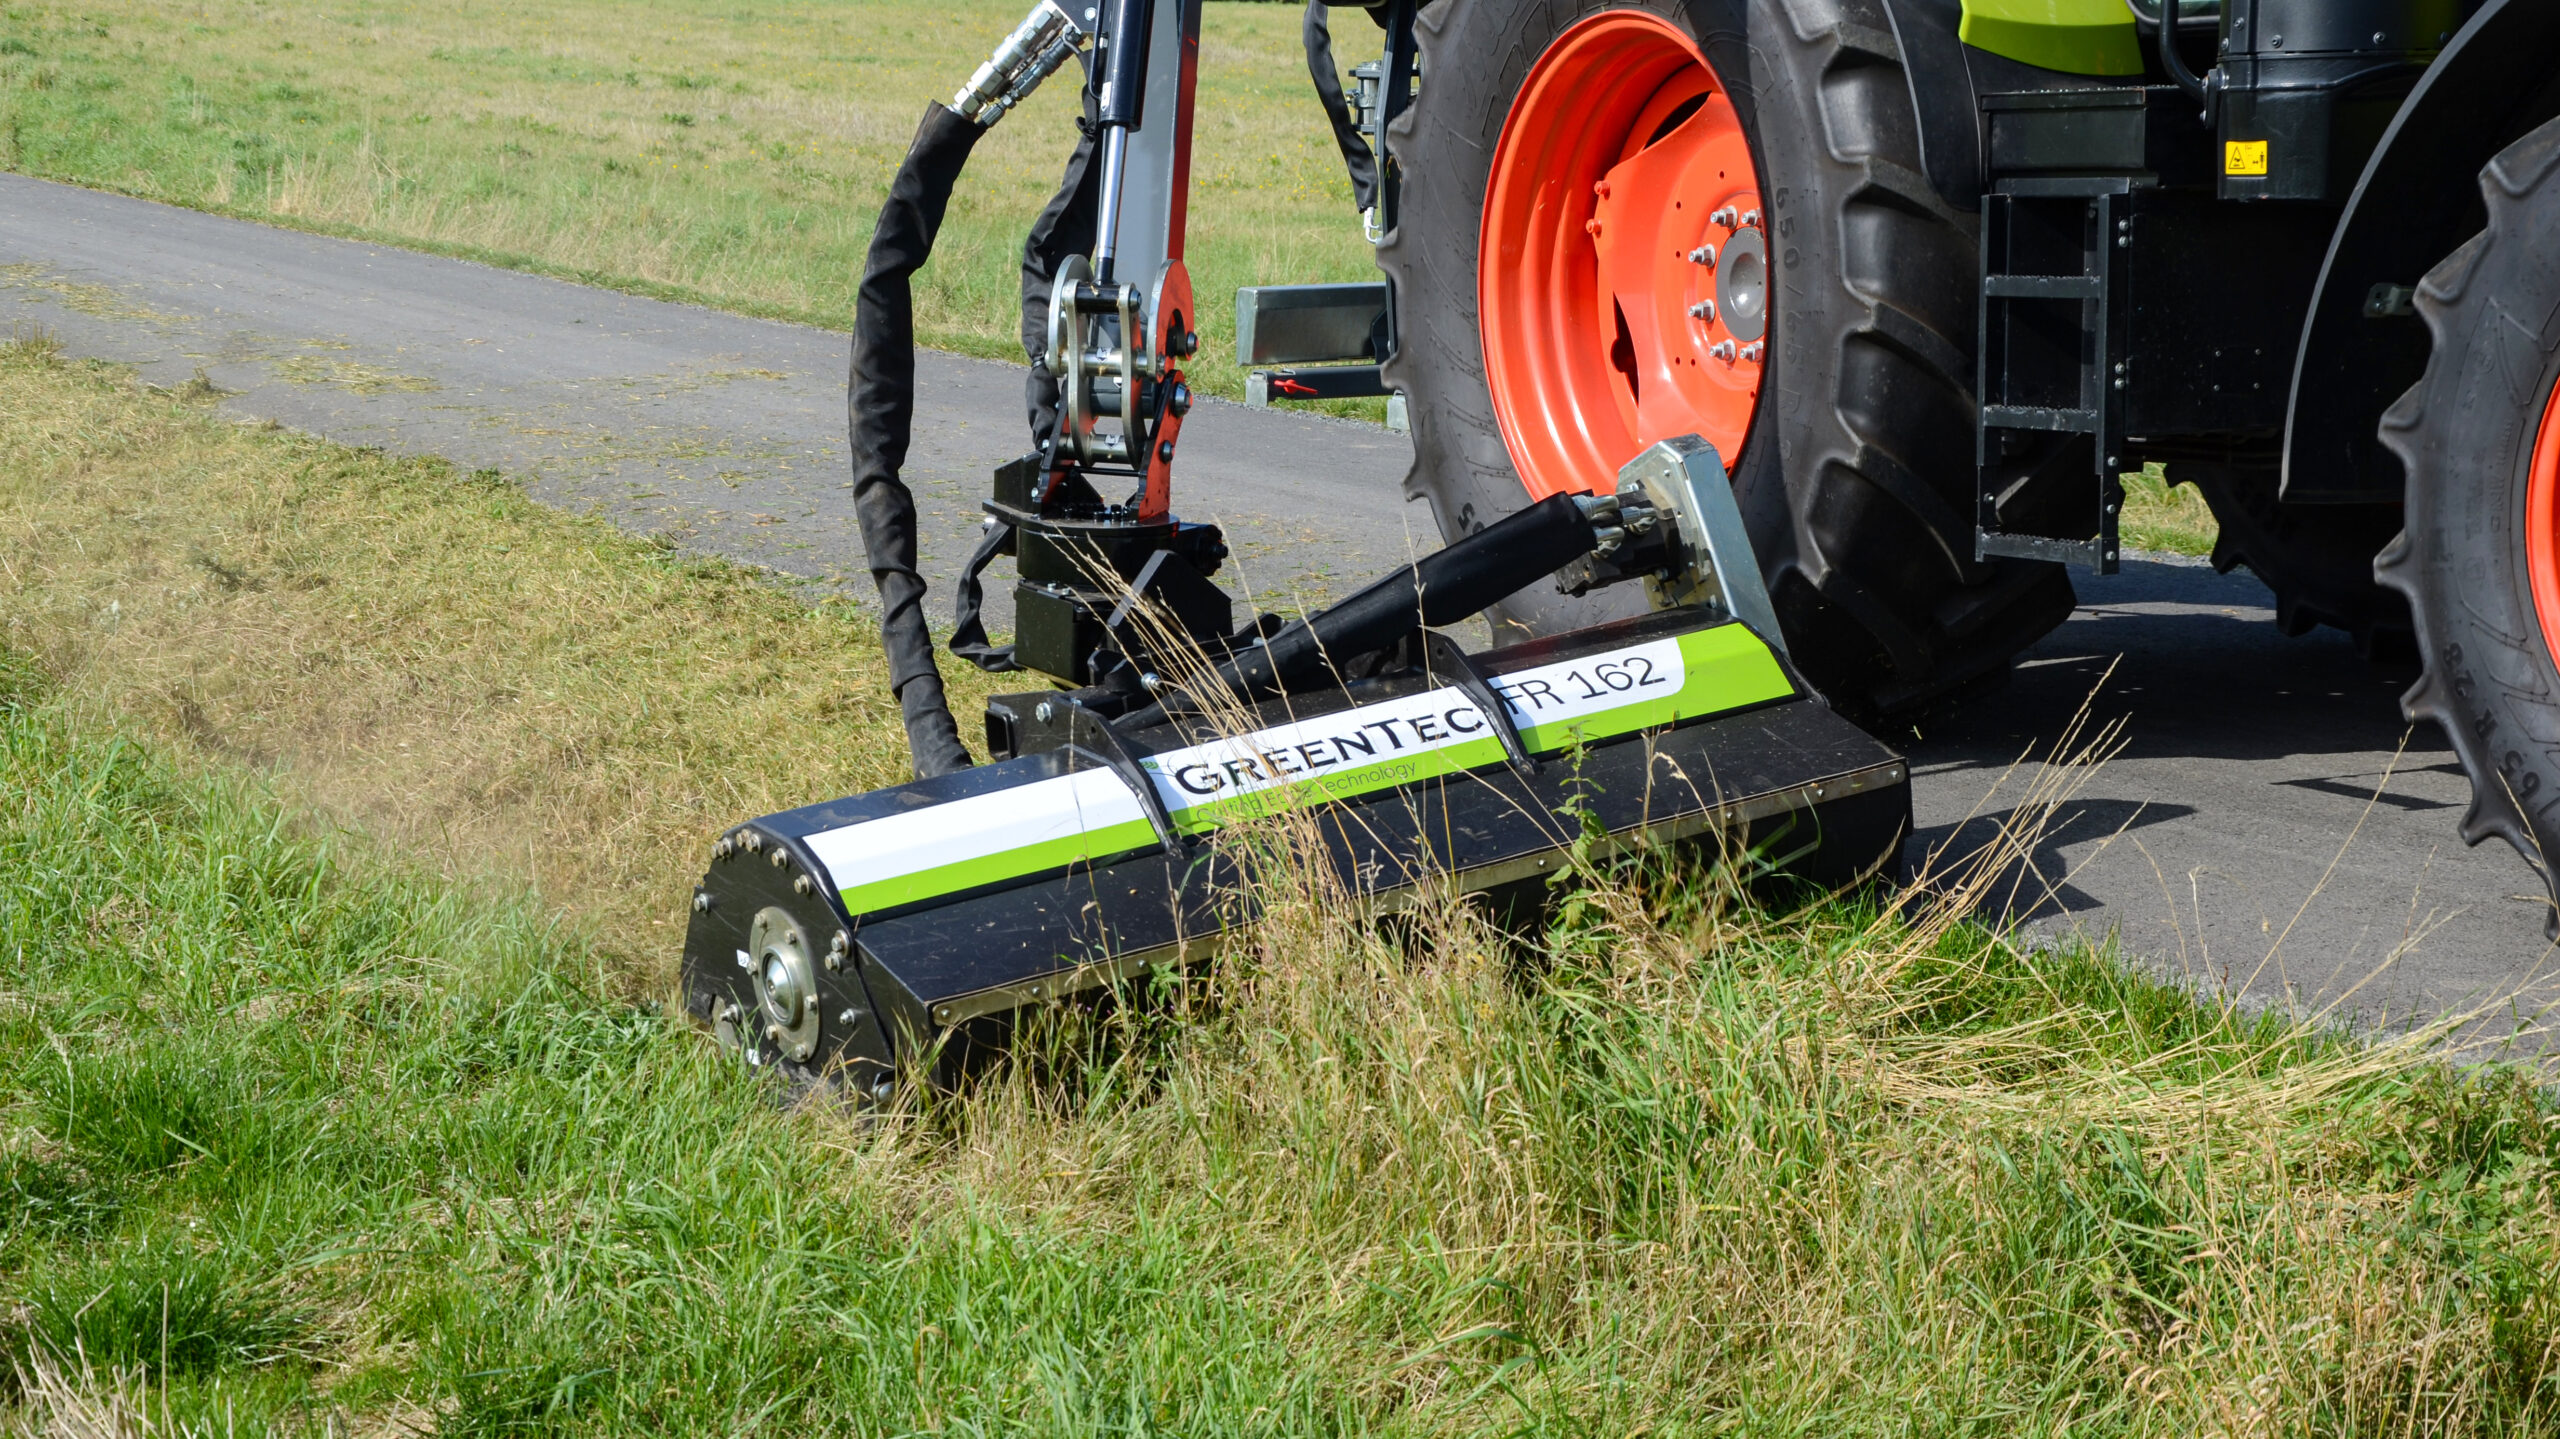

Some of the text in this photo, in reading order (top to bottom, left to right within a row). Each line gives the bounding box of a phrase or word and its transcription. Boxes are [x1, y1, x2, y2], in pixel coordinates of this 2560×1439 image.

[2443, 641, 2476, 697] 28
[1175, 657, 1666, 795] GREENTEC FR 162
[2474, 708, 2499, 743] R
